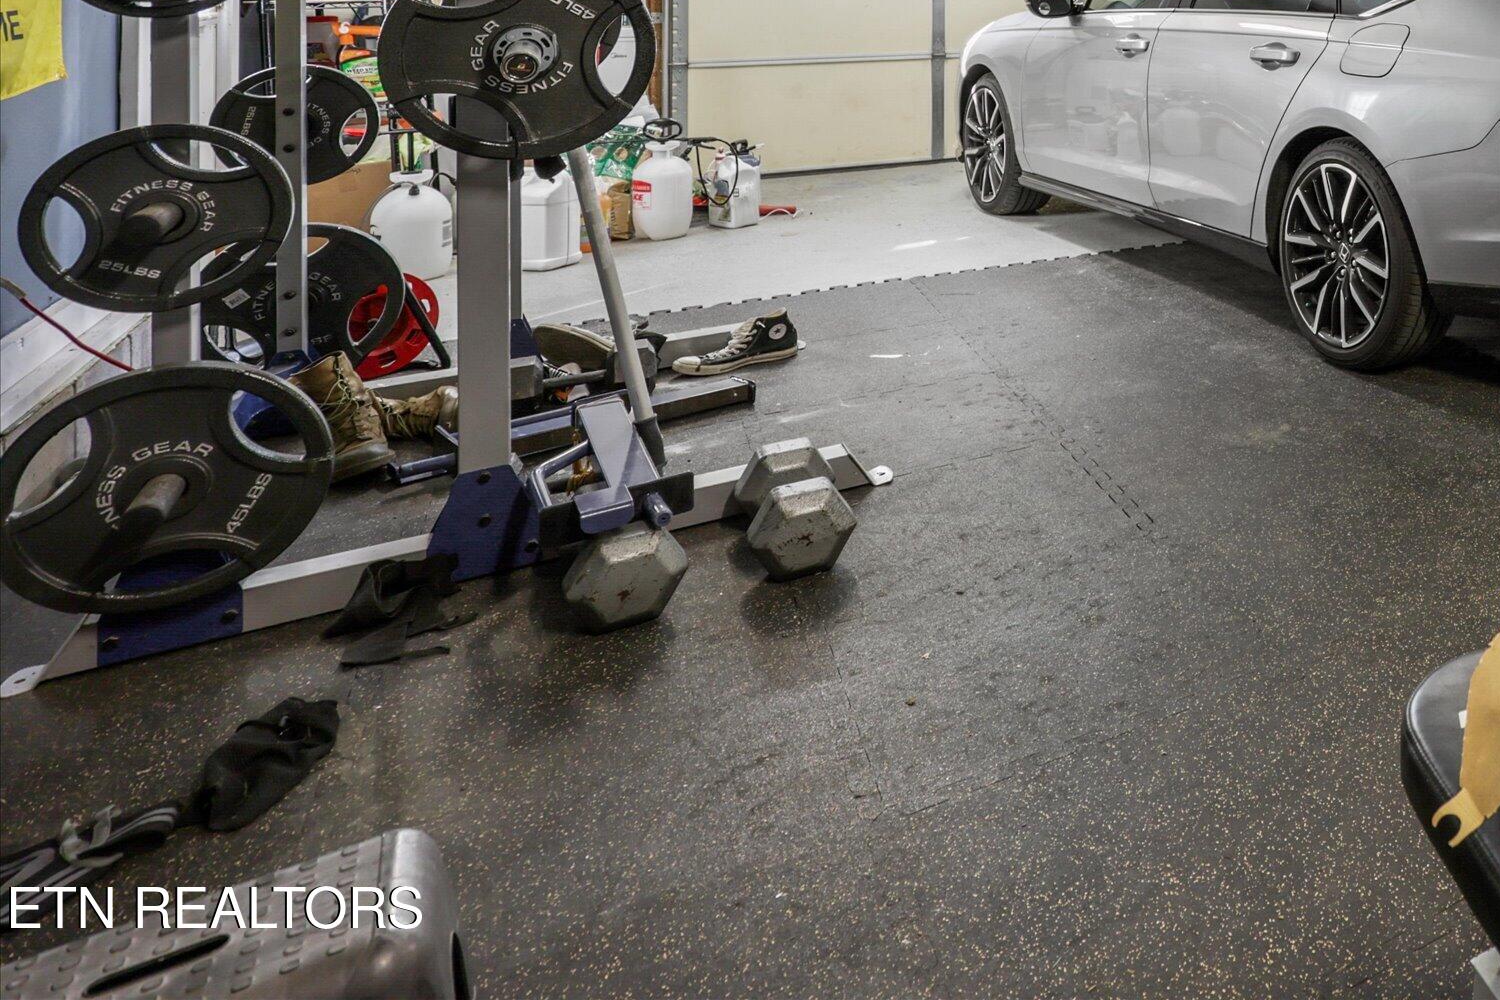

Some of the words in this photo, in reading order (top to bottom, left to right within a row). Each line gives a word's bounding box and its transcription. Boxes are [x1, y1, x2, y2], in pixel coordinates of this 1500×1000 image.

[470, 20, 500, 71] GEAR
[485, 61, 574, 94] FITNESS
[307, 103, 331, 135] ITNESS
[110, 180, 194, 213] FITNESS
[196, 190, 216, 232] GEAR
[99, 260, 162, 279] 25LBS
[254, 280, 276, 321] FITNE
[309, 272, 342, 301] GEAR
[96, 465, 127, 530] NESS
[131, 440, 214, 462] GEAR
[226, 473, 273, 534] 45LBS
